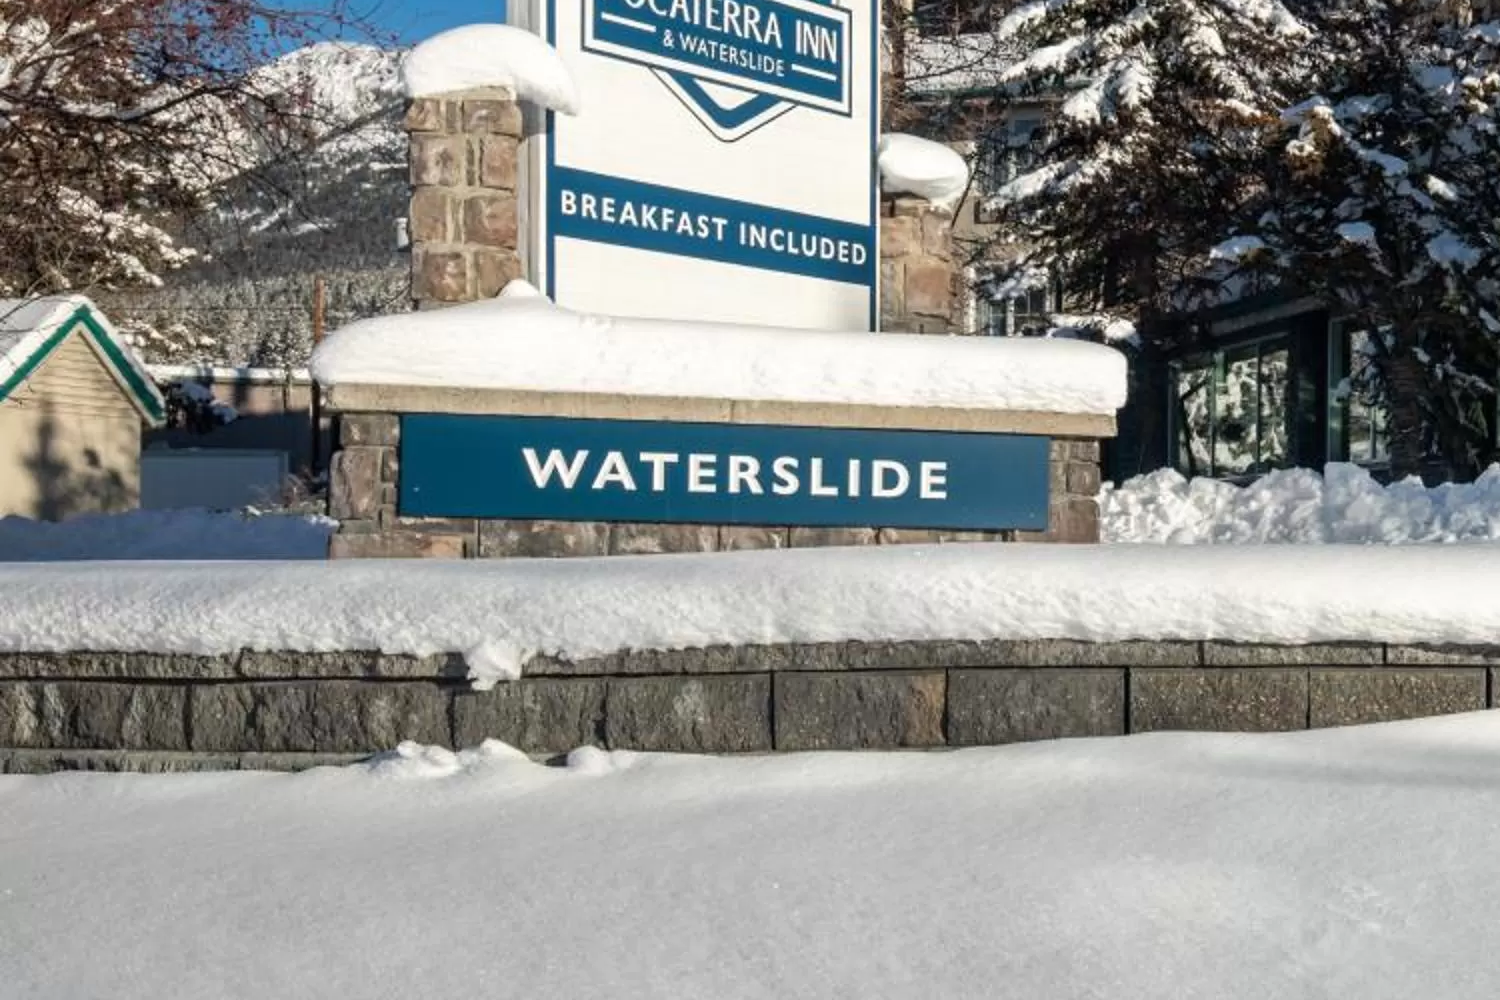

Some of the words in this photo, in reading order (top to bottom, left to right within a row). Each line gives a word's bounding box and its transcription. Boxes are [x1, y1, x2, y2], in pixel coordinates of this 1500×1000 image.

[663, 29, 675, 47] &
[680, 32, 785, 76] WATERSLIDE
[796, 20, 838, 63] INN
[560, 190, 728, 242] BREAKFAST
[739, 222, 867, 265] INCLUDED
[521, 447, 947, 500] WATERSLIDE
